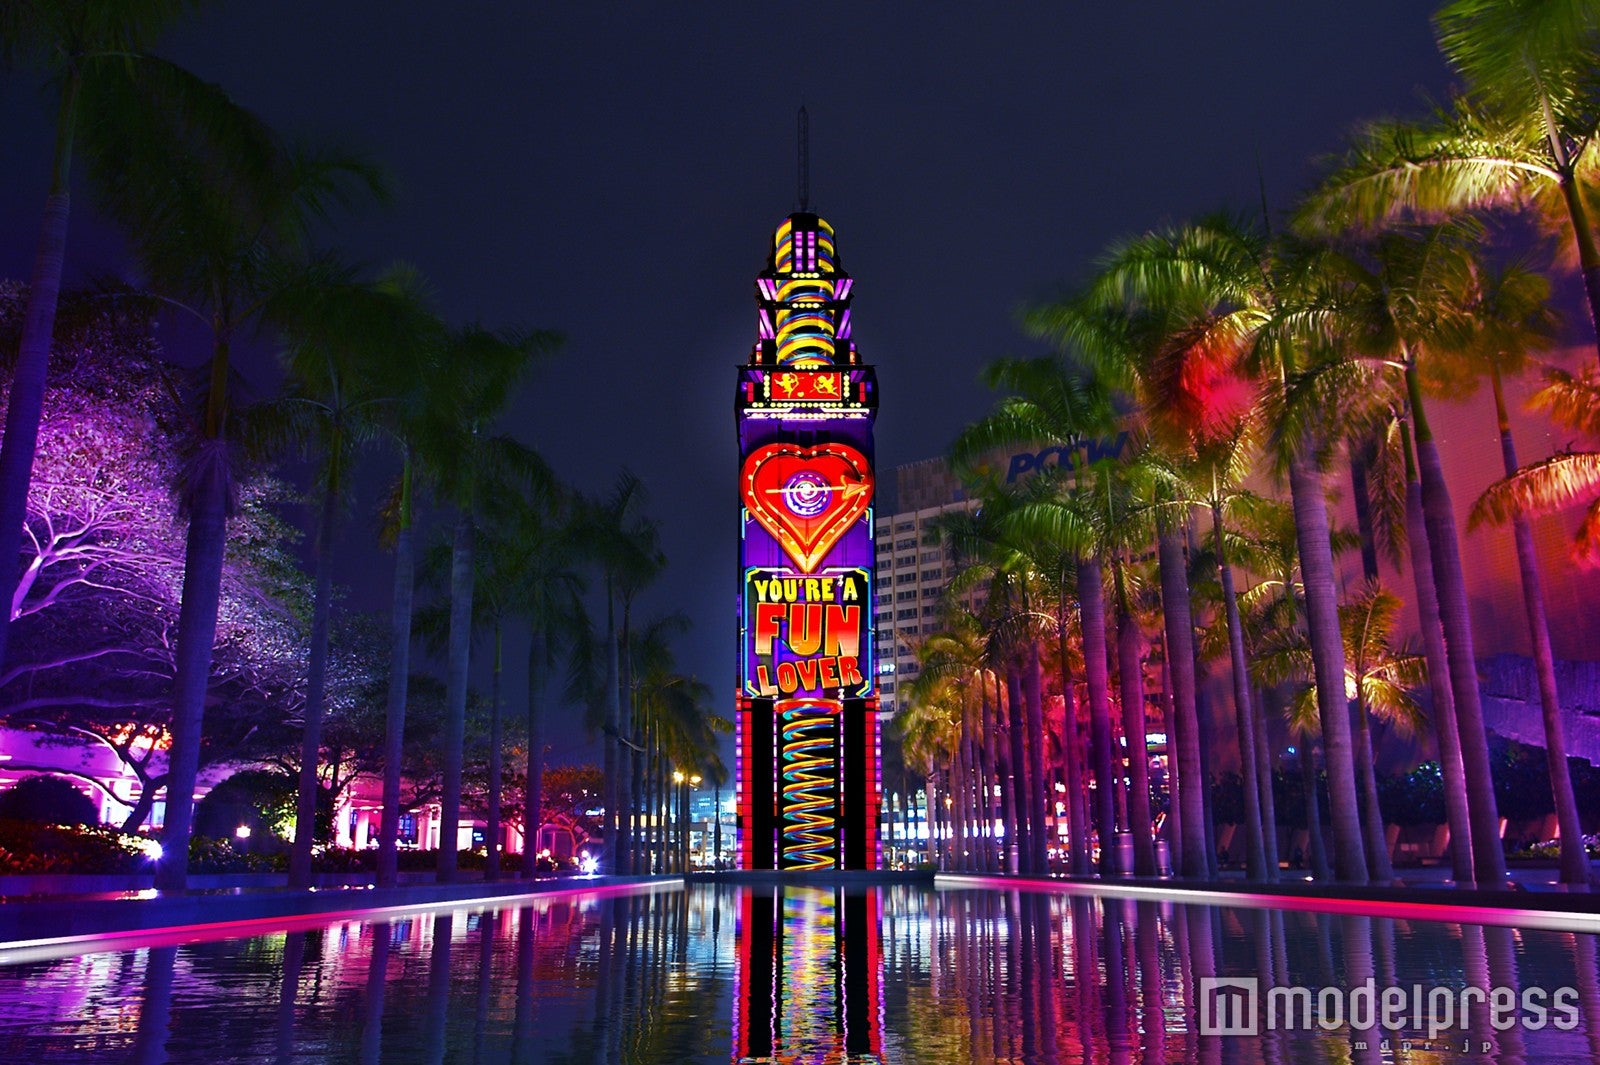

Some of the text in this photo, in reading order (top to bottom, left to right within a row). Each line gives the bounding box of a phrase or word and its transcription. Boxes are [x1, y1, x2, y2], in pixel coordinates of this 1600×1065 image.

[754, 577, 858, 602] YOU'RE A
[755, 602, 860, 657] FUN
[757, 656, 863, 696] LOVER
